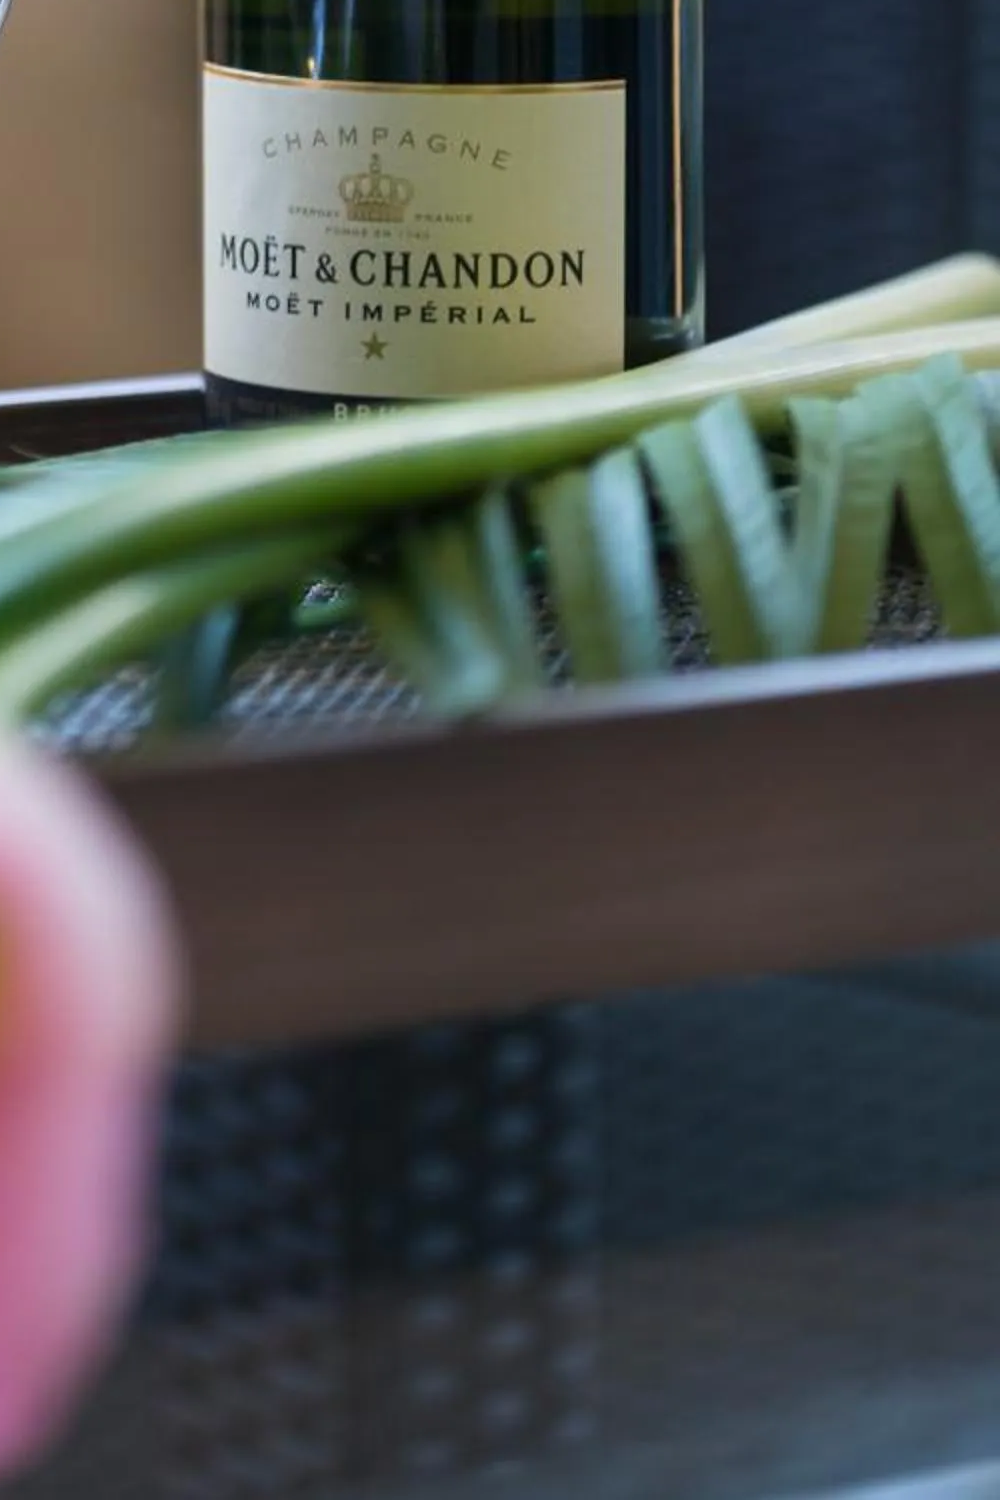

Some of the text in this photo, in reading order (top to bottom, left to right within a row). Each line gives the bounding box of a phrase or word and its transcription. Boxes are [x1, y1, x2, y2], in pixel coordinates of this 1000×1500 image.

[262, 126, 513, 171] CHAMPAGNE
[220, 234, 586, 290] MOËT & CHANDON
[246, 291, 537, 324] MOËT IMPÉRIAL
